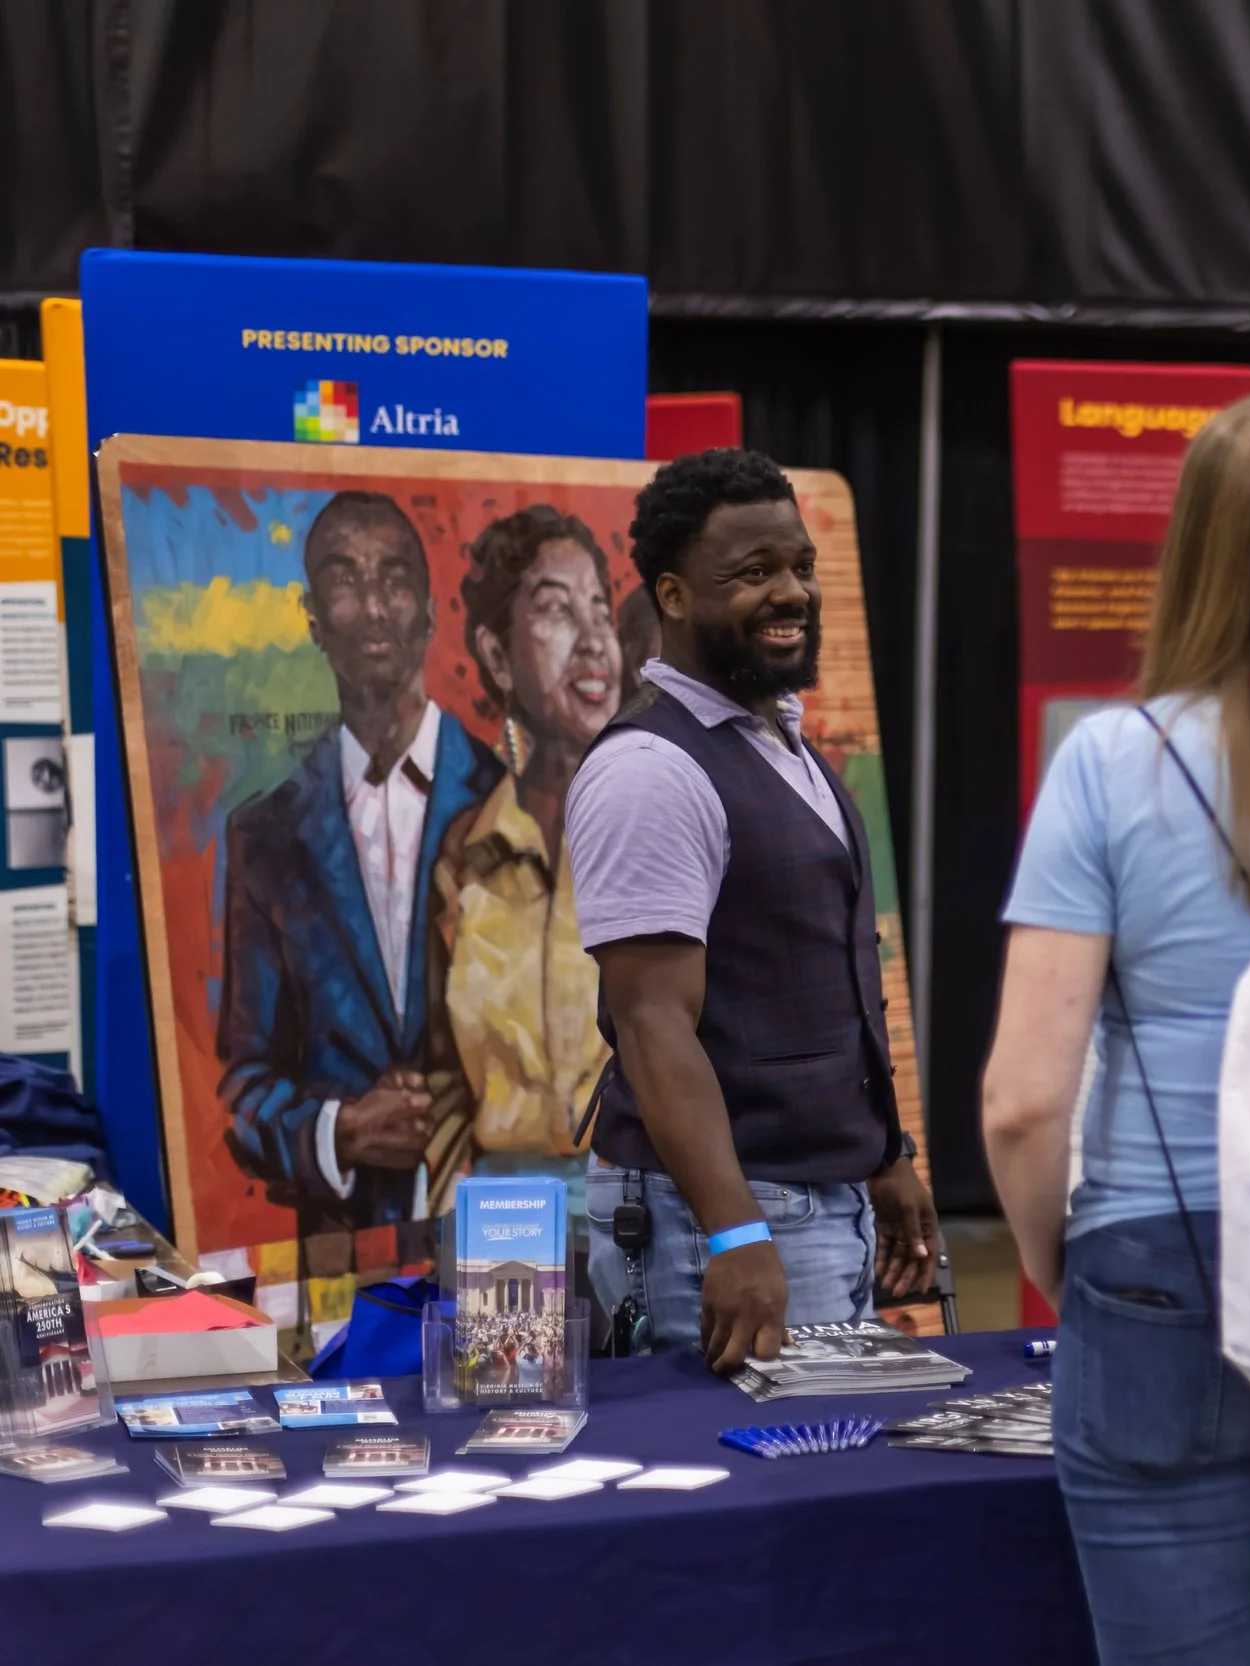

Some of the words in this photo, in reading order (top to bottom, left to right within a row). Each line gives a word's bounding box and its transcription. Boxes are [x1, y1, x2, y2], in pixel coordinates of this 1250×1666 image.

[242, 329, 390, 354] PRESENTING
[395, 335, 508, 359] SPONSOR
[370, 404, 460, 436] Altria
[479, 1199, 547, 1210] MEMBERSHIP
[482, 1227, 512, 1238] YOUR
[512, 1226, 543, 1238] STORY
[26, 1304, 71, 1323] AMERICA'S
[36, 1317, 63, 1333] 250TH
